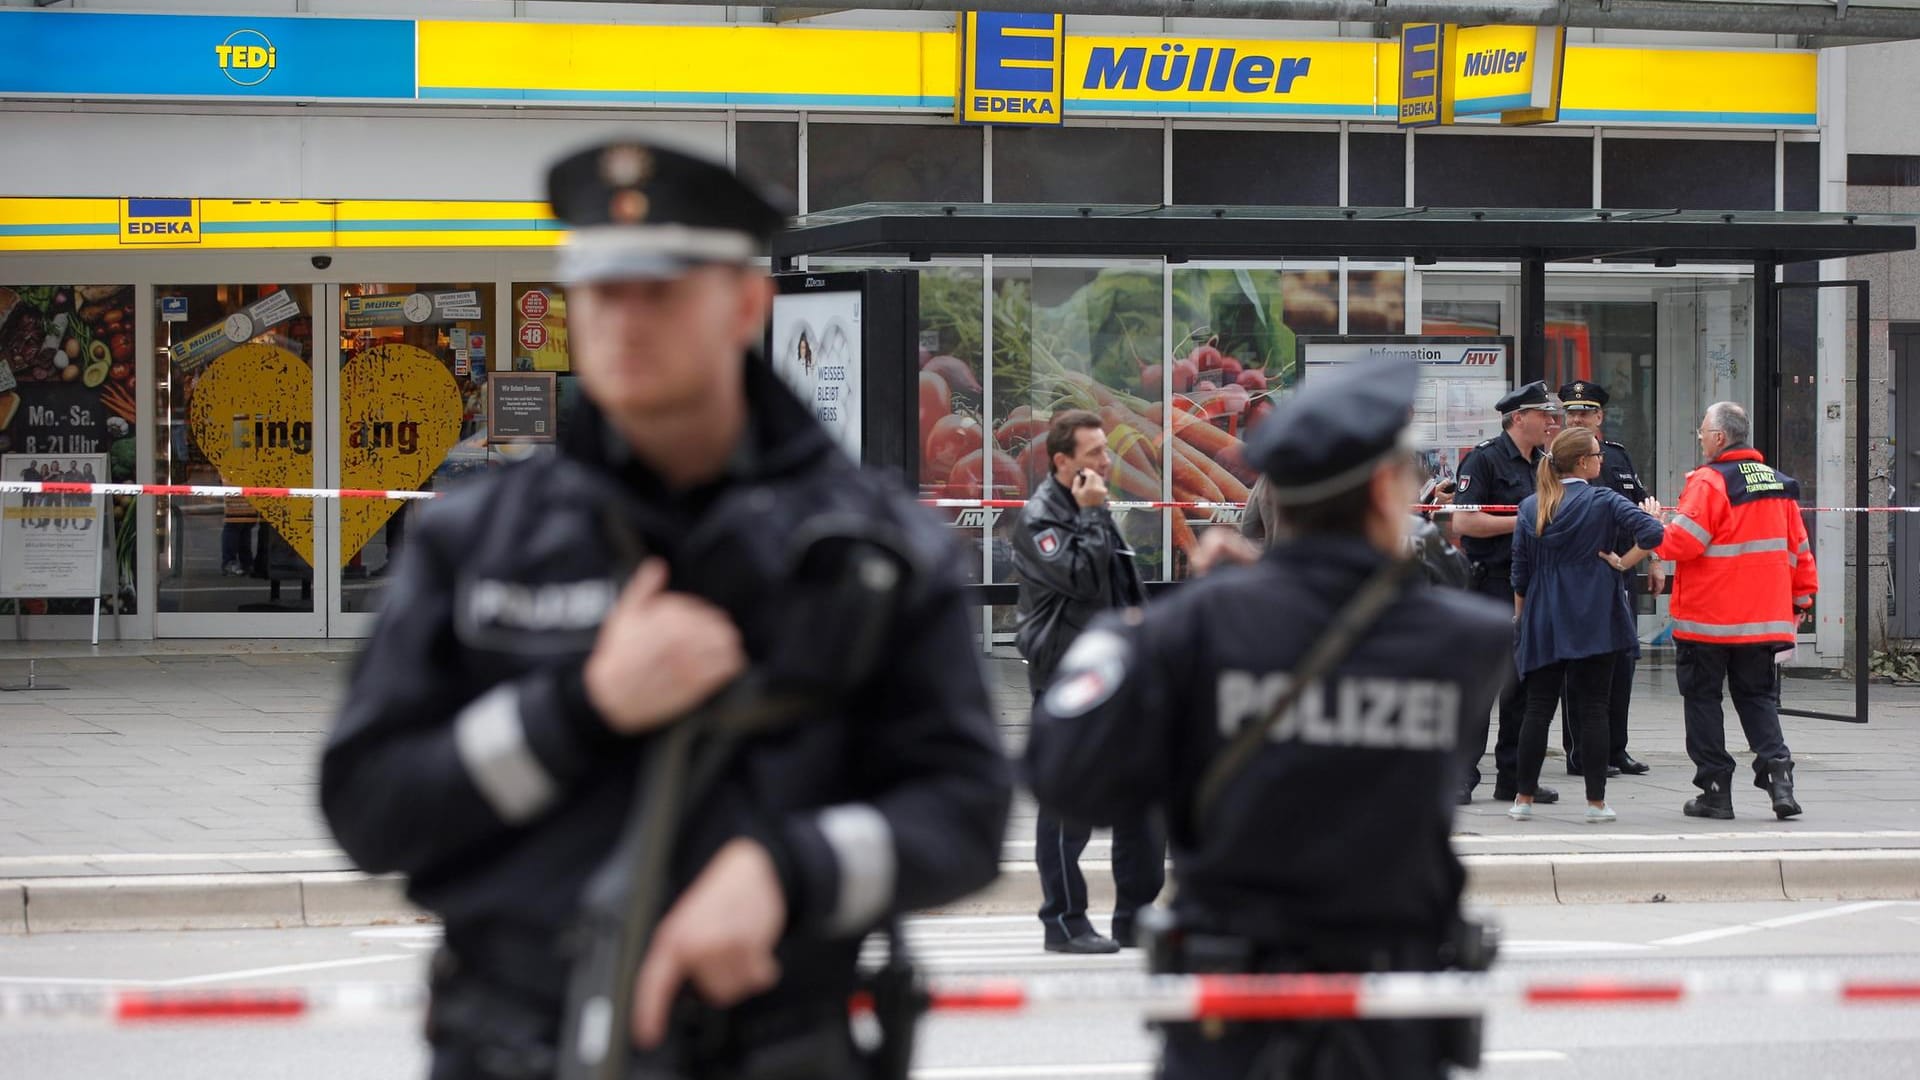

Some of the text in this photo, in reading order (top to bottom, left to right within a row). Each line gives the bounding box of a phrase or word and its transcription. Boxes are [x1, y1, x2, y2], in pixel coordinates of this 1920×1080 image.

[216, 45, 276, 68] TEDi
[1464, 47, 1528, 79] Müller
[1083, 43, 1311, 95] Müller
[973, 97, 1054, 114] EDEKA
[1402, 102, 1435, 118] EDEKA
[128, 221, 193, 235] EDEKA
[364, 299, 401, 309] Müller
[189, 327, 222, 350] Müller
[1369, 347, 1441, 360] Information
[1465, 352, 1499, 365] HVV
[817, 366, 845, 380] WEISSES
[817, 387, 839, 401] BLEIBT
[816, 407, 838, 421] WEISS
[232, 414, 419, 455] Eingang
[69, 435, 99, 454] Uhr
[1216, 509, 1244, 523] HV
[1217, 669, 1460, 752] POLIZEI
